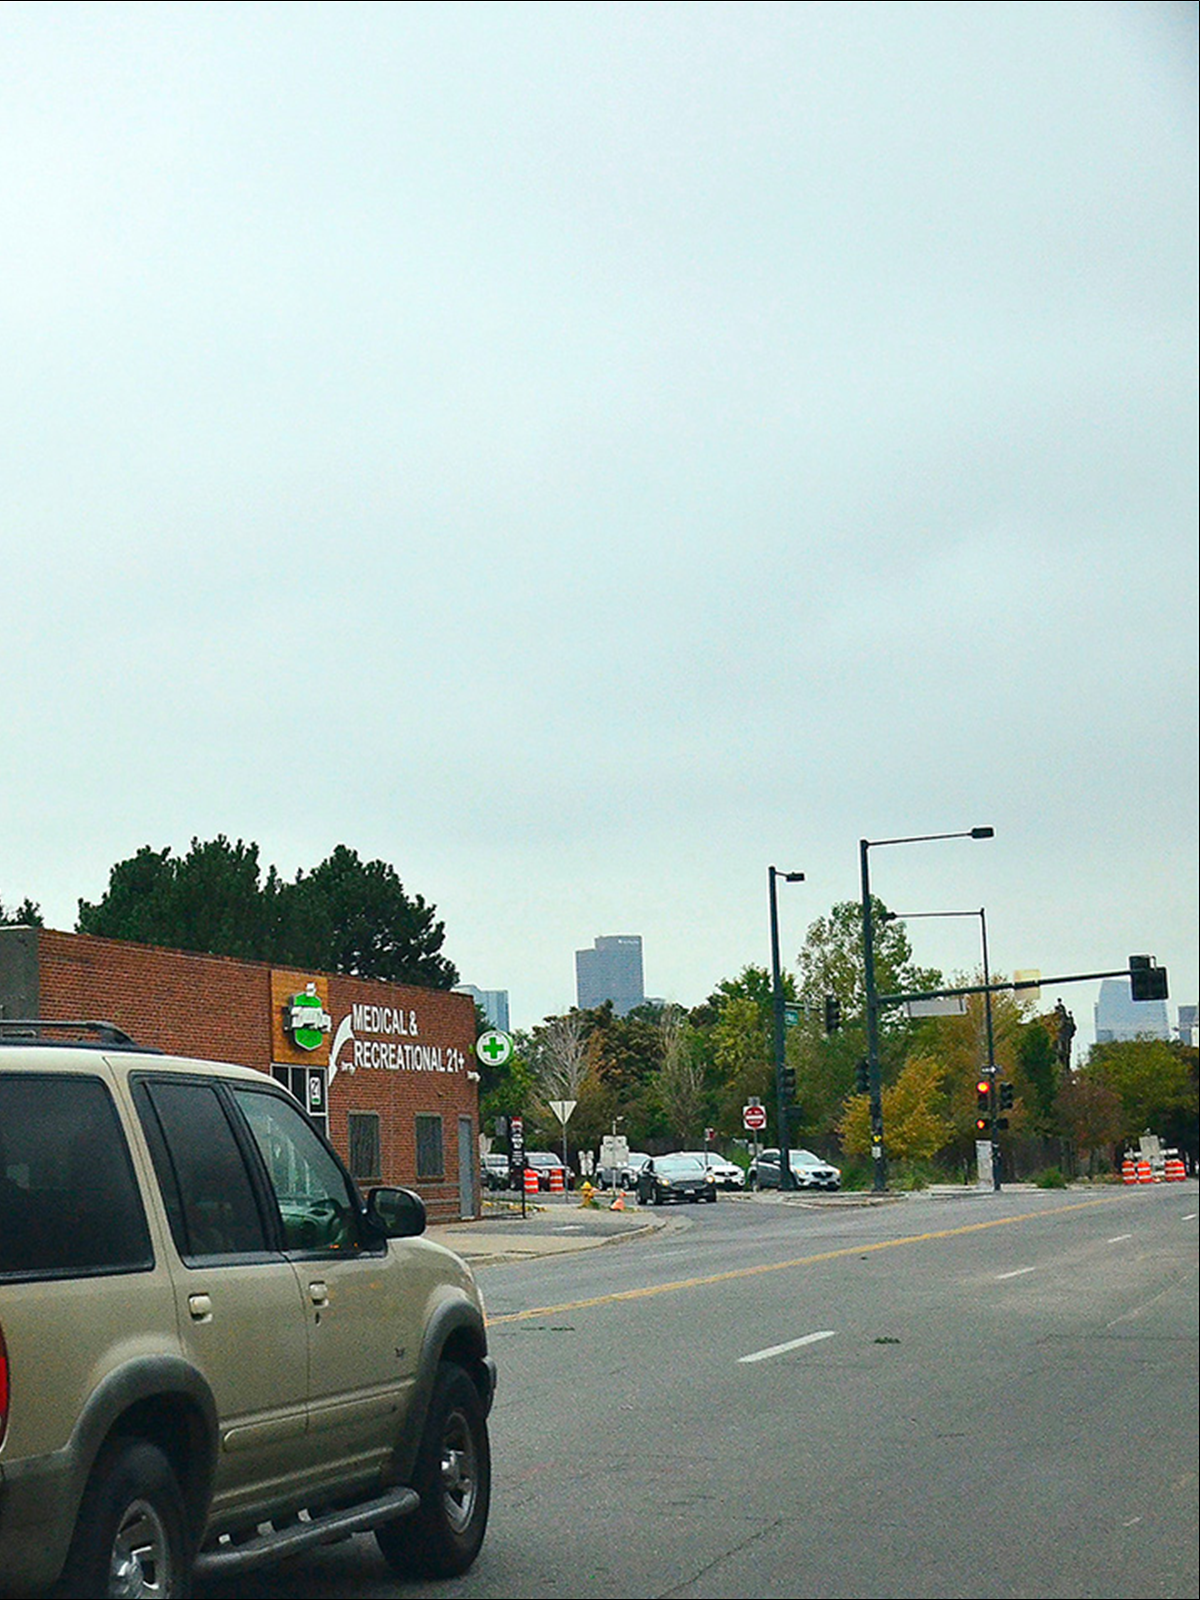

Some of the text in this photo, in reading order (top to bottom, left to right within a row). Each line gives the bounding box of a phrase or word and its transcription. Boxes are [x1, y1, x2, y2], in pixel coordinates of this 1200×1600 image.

[352, 1003, 408, 1036] MEDICAL
[408, 1010, 419, 1037] &
[354, 1039, 465, 1073] RECREATIONAL 21+
